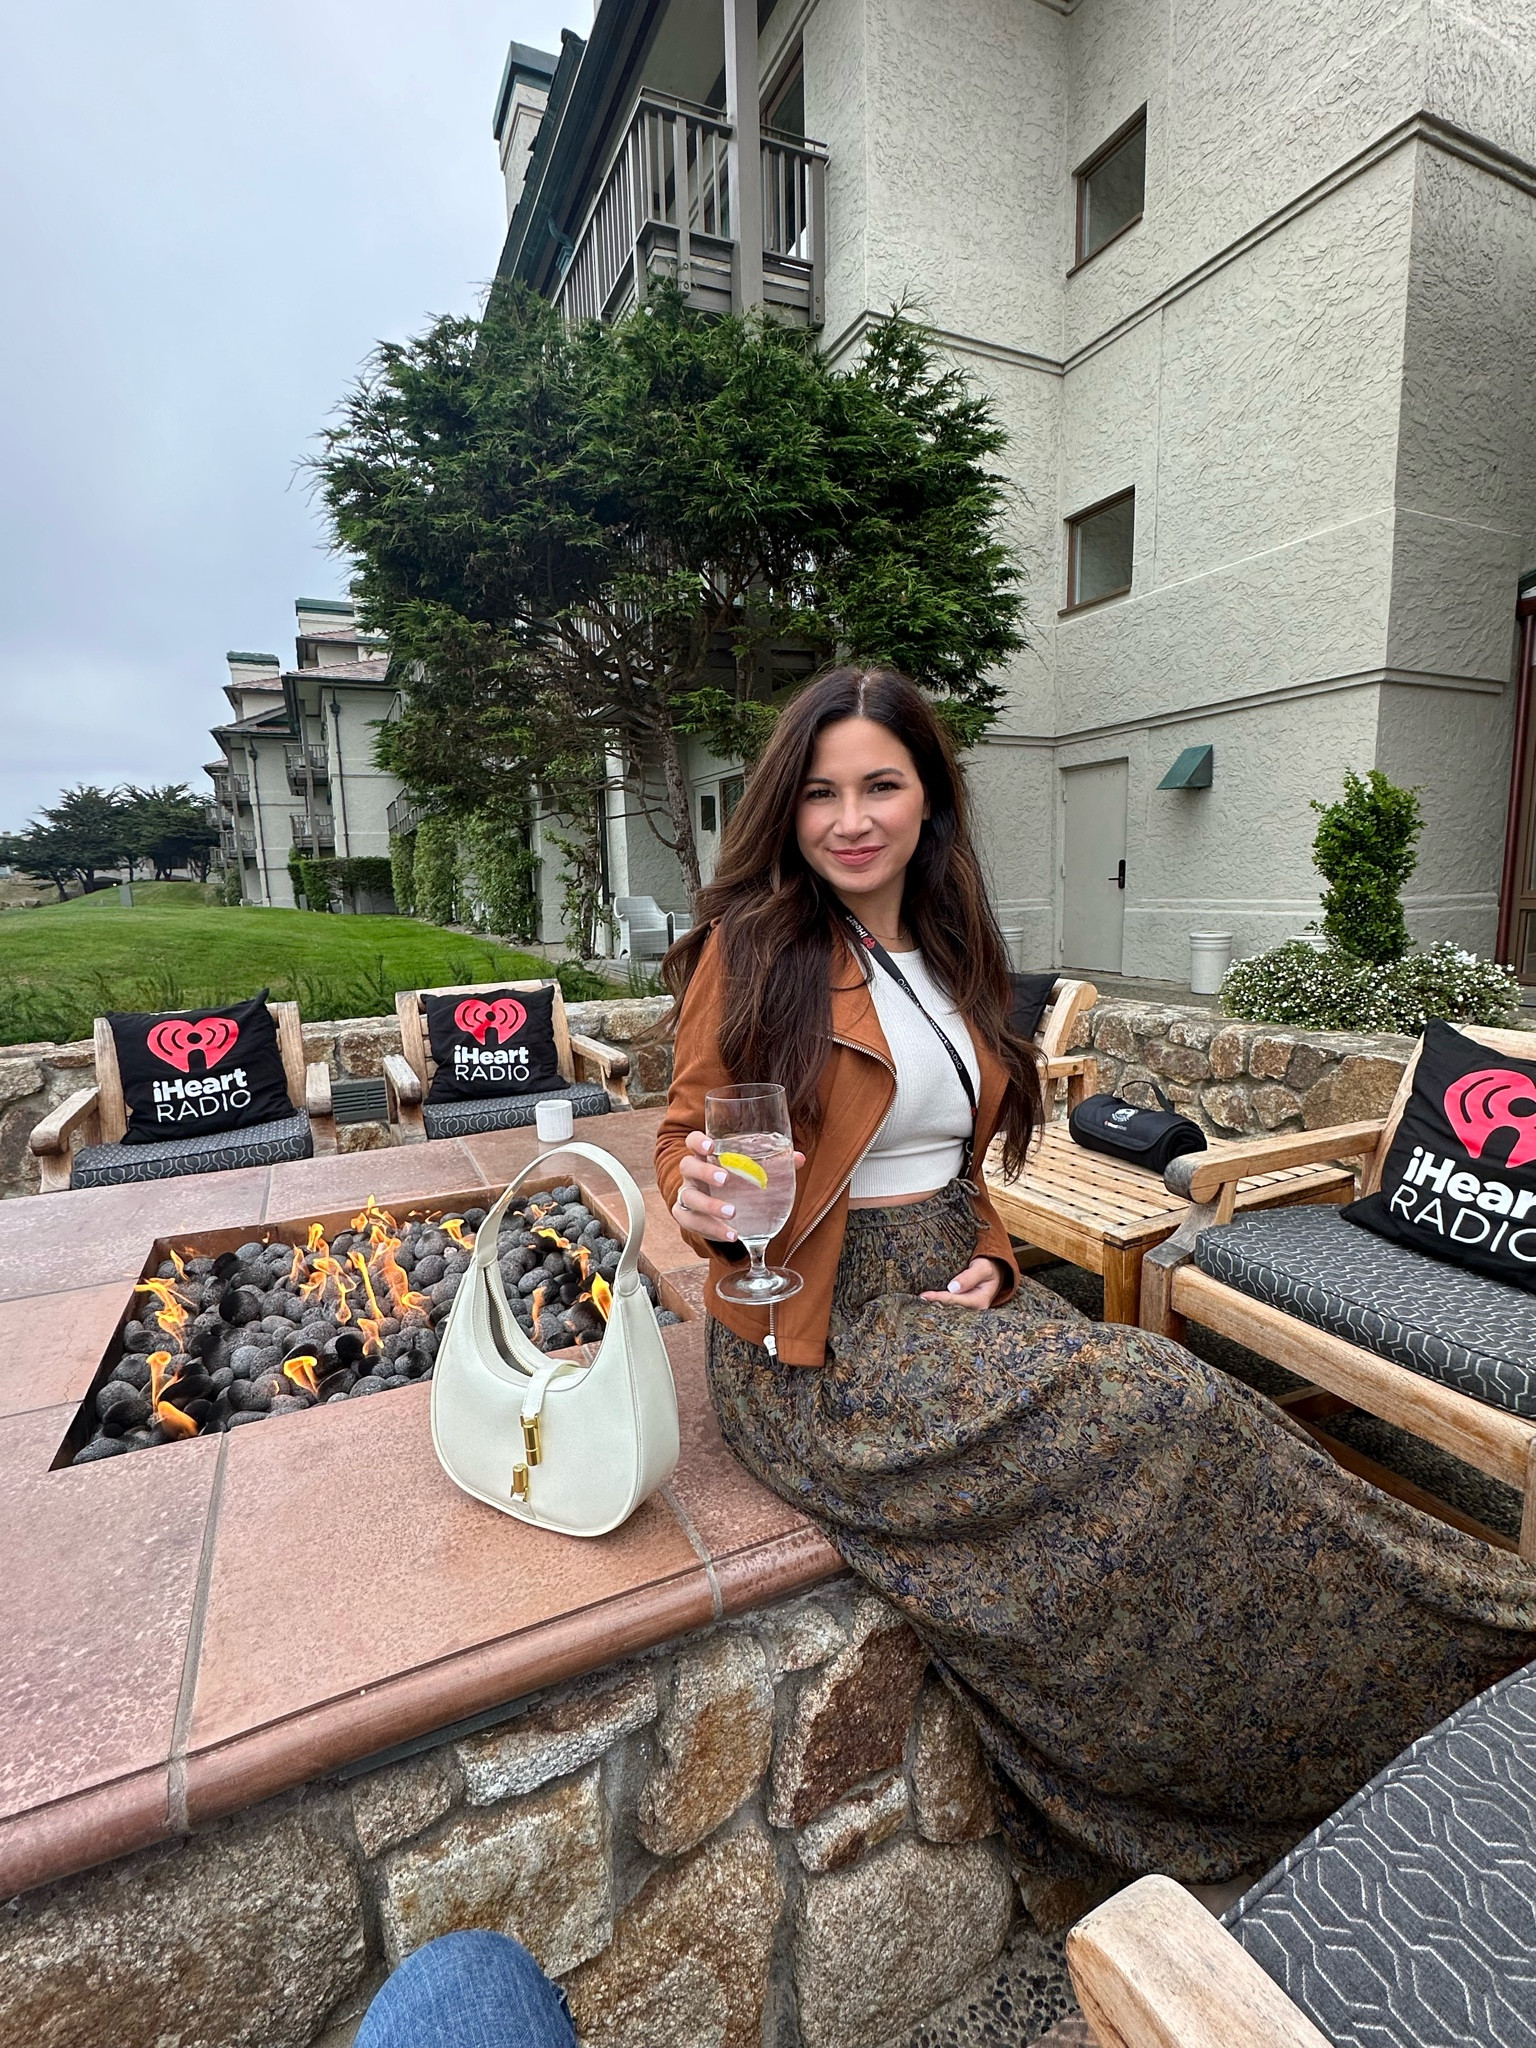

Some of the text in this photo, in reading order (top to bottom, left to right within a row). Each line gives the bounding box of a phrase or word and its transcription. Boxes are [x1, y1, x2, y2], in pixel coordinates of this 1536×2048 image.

[453, 1044, 529, 1065] iHeart
[152, 1067, 248, 1103] iHeart
[455, 1065, 530, 1082] RADIO
[156, 1089, 251, 1123] RADIO
[1389, 1183, 1536, 1262] RADIO
